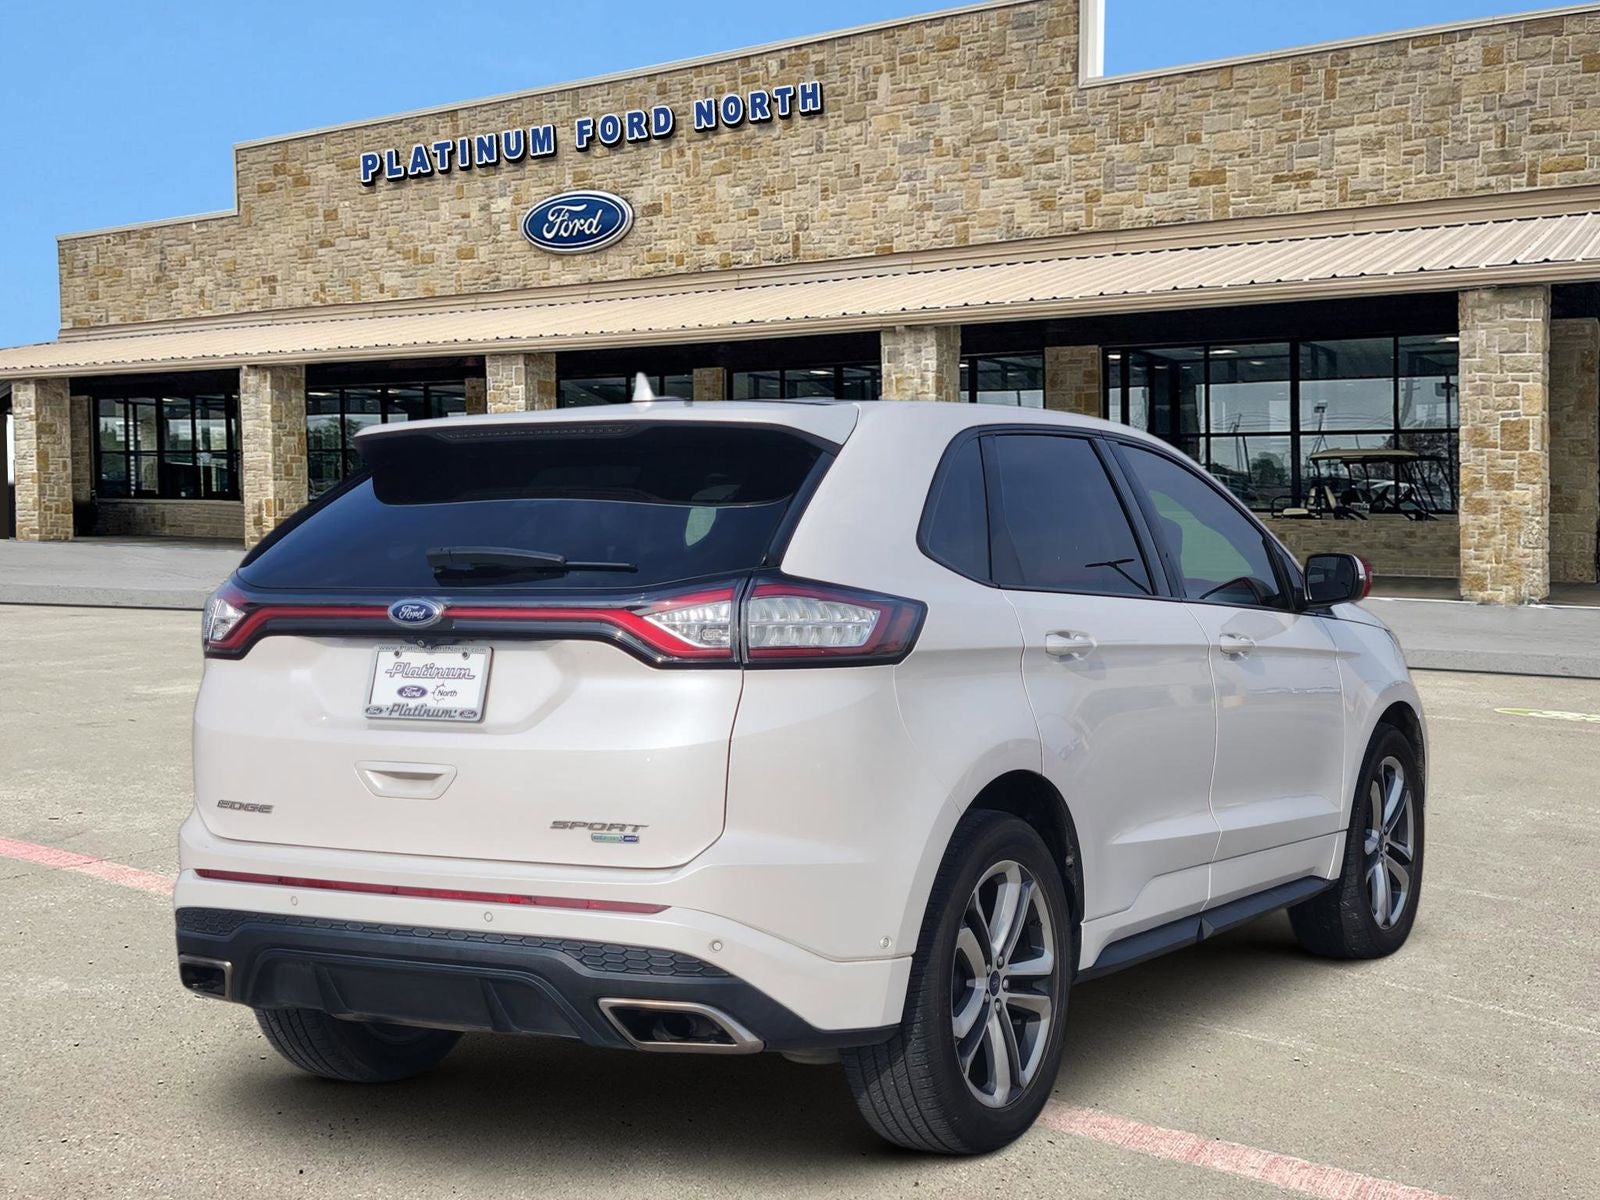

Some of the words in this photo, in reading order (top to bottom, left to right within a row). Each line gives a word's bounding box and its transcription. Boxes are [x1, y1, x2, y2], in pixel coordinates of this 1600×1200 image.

[361, 124, 555, 184] PLATINUM
[575, 105, 674, 149] FORD
[693, 81, 821, 130] NORTH
[542, 204, 603, 239] Ford
[399, 604, 427, 620] Ford
[385, 661, 476, 680] Platinum
[437, 689, 458, 697] North
[388, 702, 457, 718] Platinum
[217, 799, 273, 814] EDGE
[550, 820, 650, 833] SPORT
